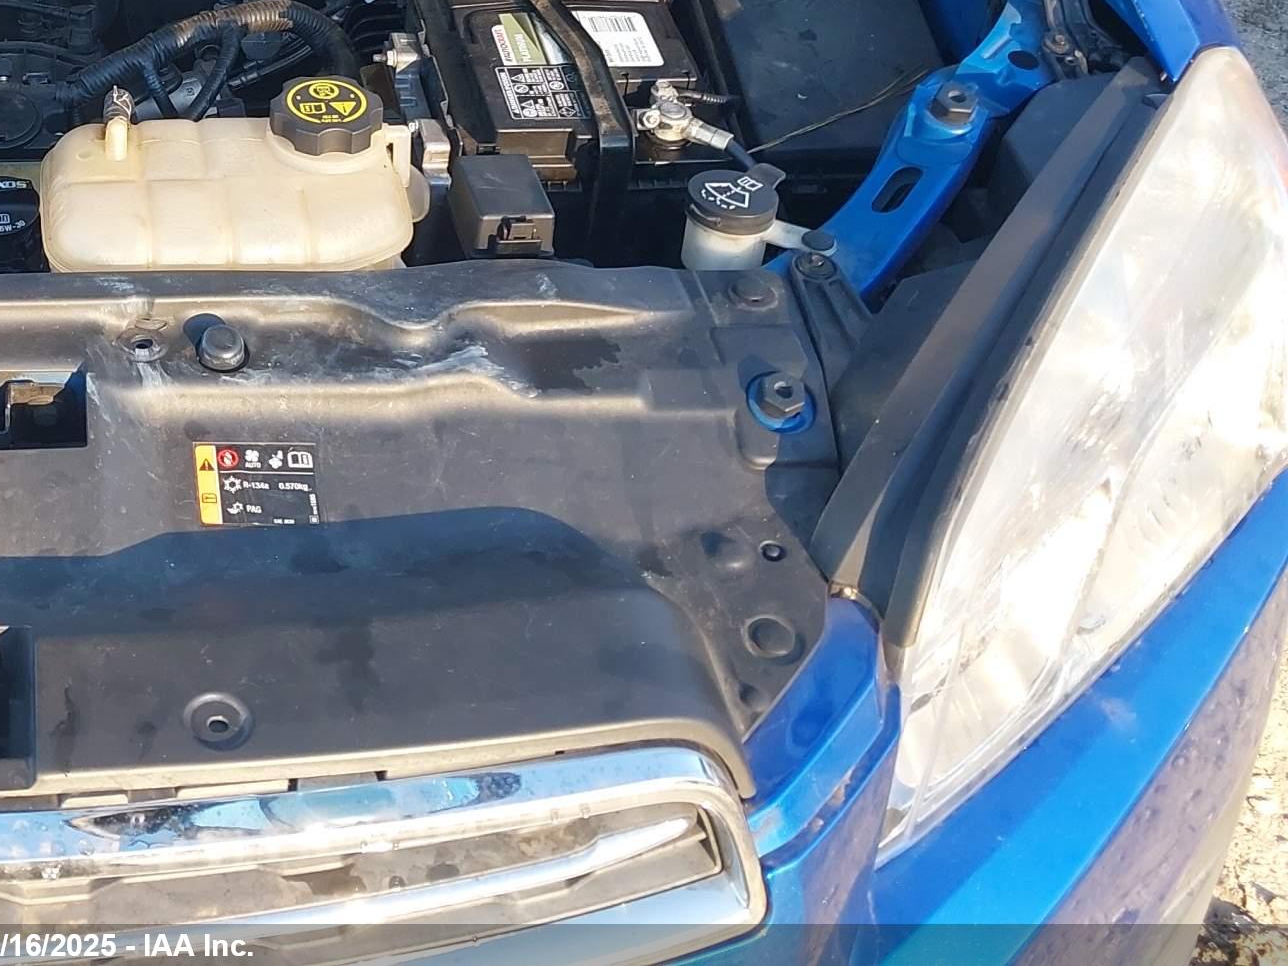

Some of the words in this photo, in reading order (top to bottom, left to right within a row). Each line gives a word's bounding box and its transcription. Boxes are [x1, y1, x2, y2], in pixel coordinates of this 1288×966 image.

[245, 461, 261, 469] AUTO
[243, 481, 270, 490] R-134a
[245, 504, 262, 514] PAG
